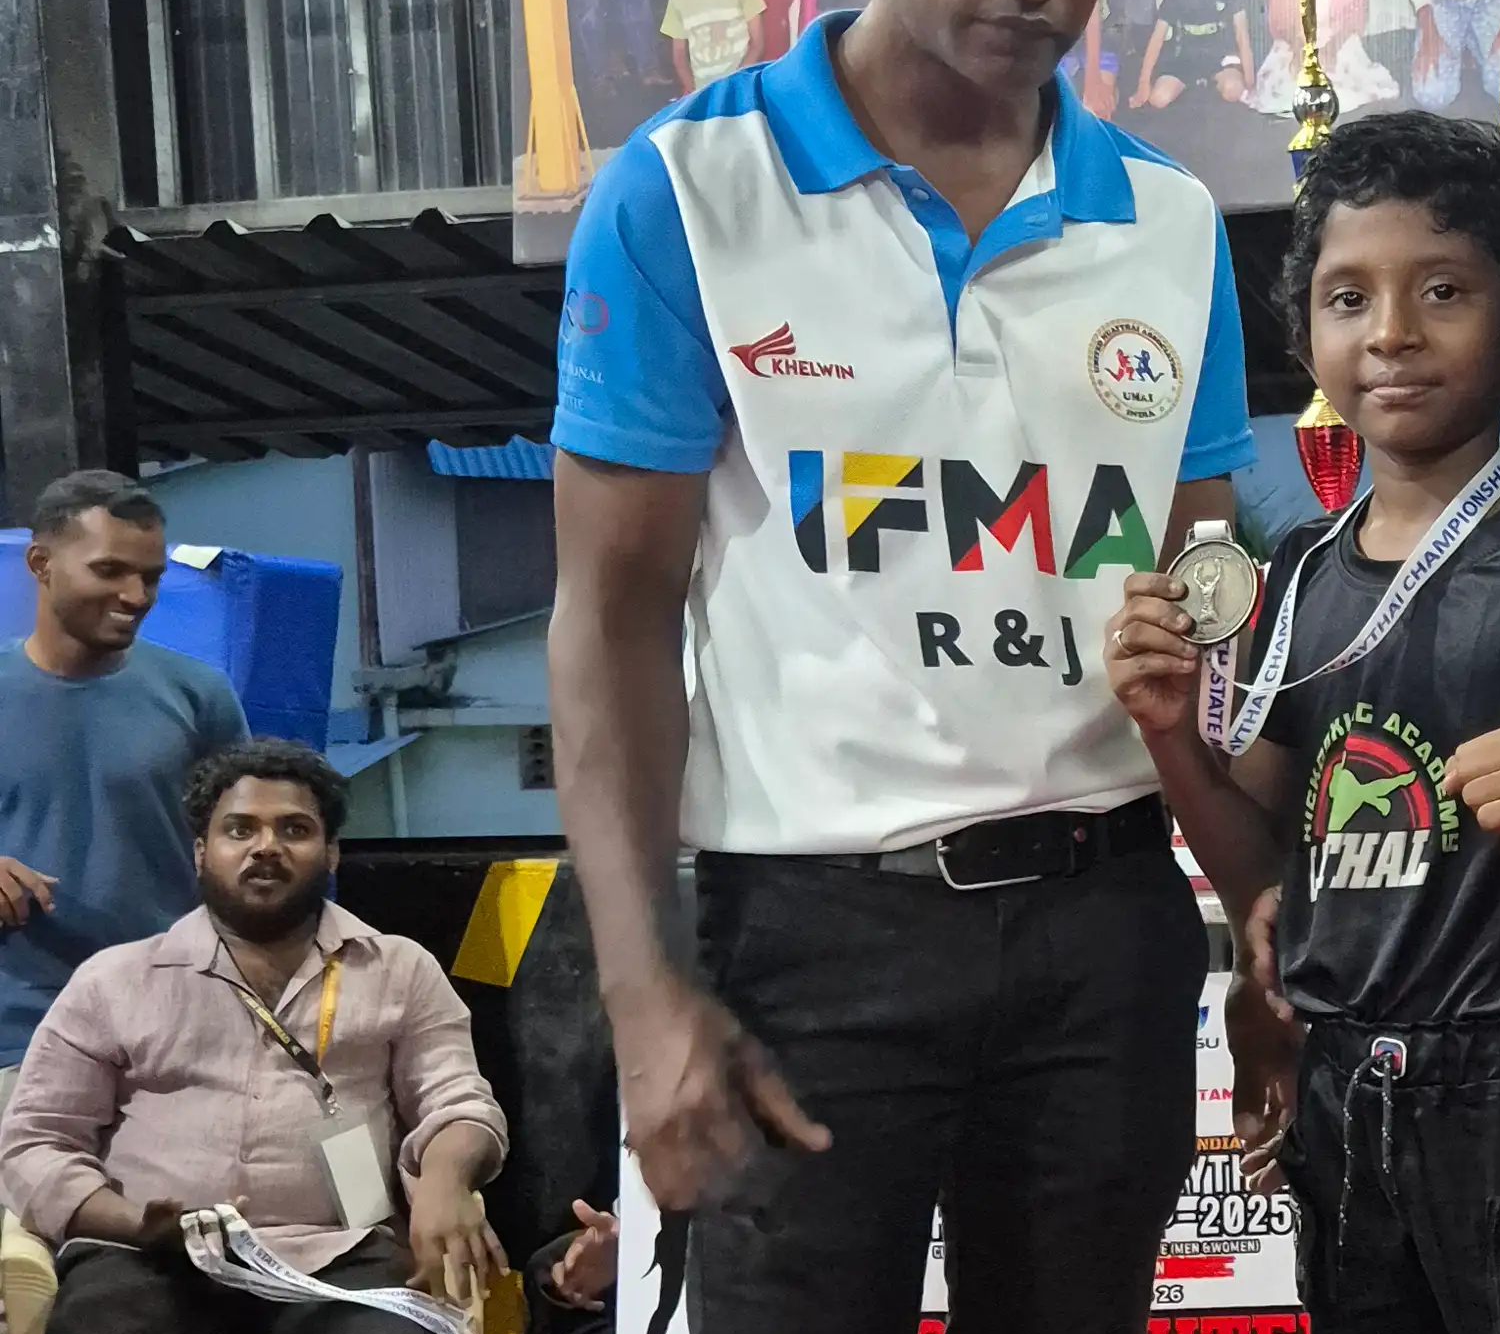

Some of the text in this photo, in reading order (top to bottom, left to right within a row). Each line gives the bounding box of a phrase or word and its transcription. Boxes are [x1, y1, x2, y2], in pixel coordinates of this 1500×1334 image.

[771, 358, 855, 380] KHELWIN
[788, 449, 1156, 580] IFMA
[916, 608, 1084, 687] R & J
[1207, 671, 1227, 735] STATE
[1196, 1137, 1243, 1151] NDIA
[1156, 1285, 1184, 1304] 26
